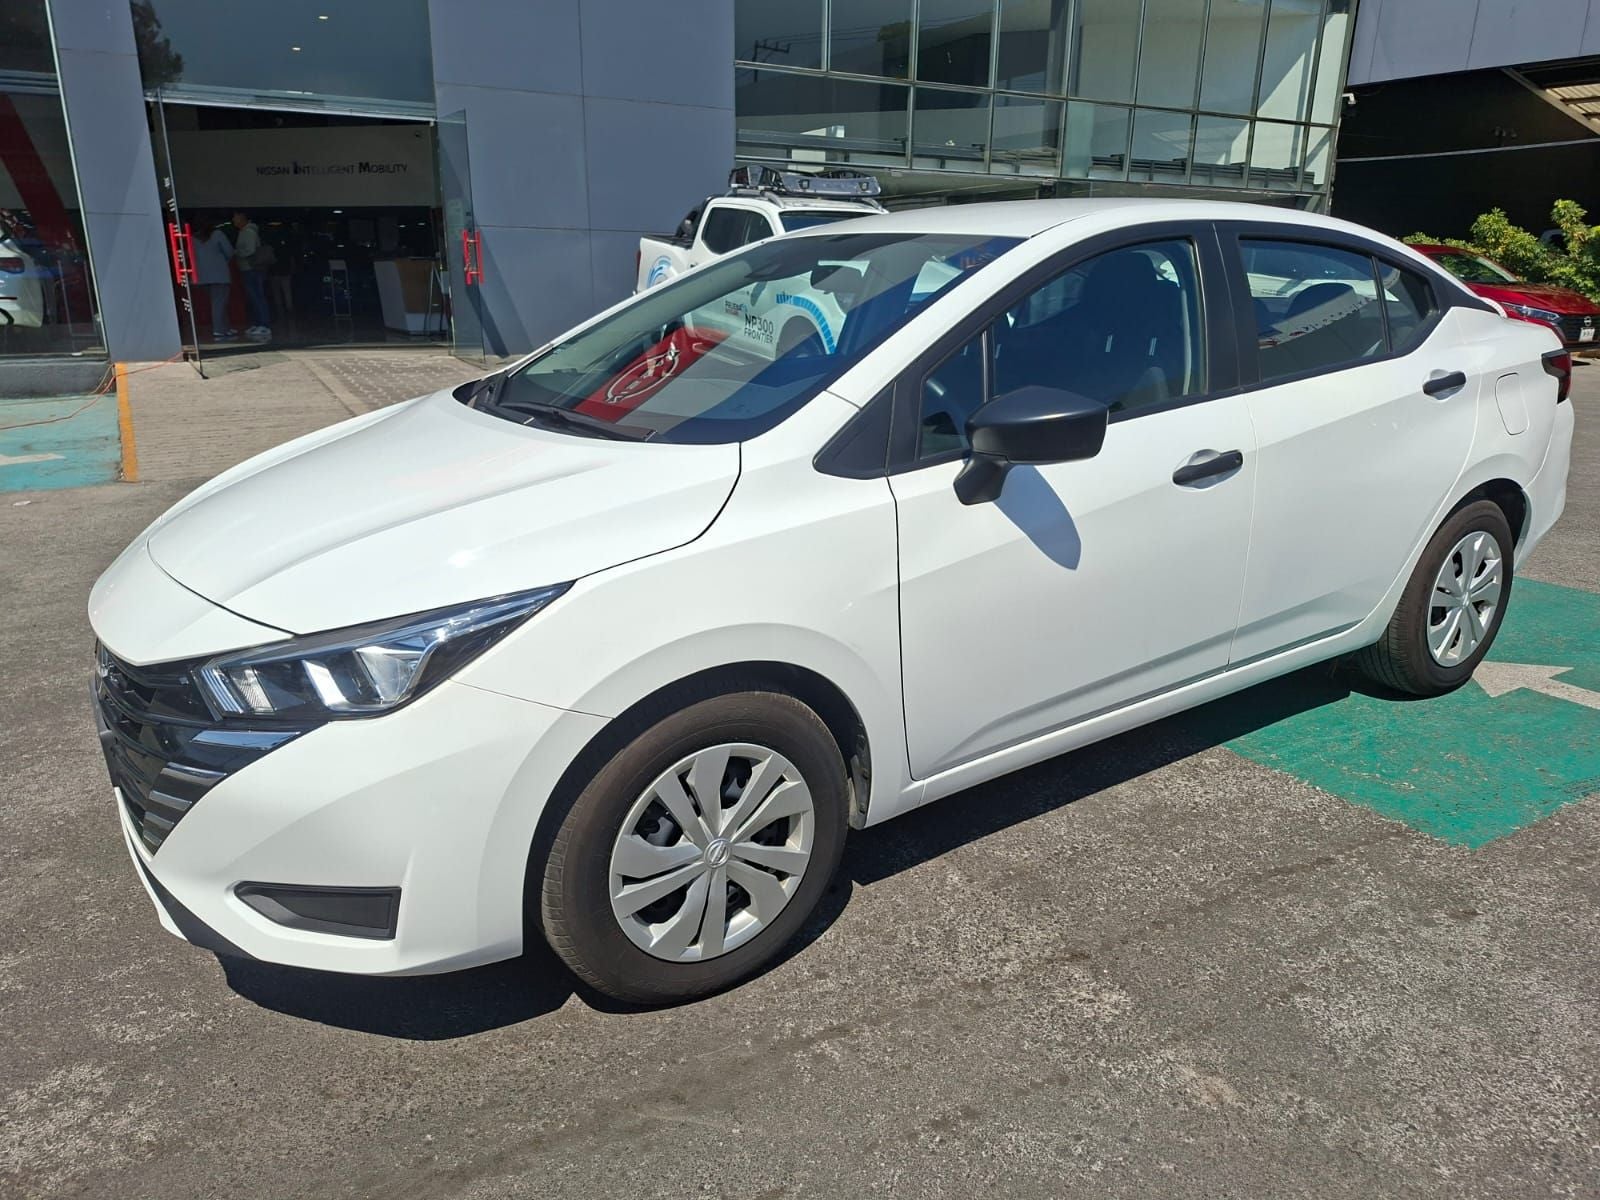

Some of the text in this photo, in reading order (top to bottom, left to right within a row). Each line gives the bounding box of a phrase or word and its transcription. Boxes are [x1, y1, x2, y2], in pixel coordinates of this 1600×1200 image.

[256, 161, 408, 176] NISSAN INTELLIGENT MOBILITY
[744, 313, 774, 335] NP300
[744, 327, 774, 344] FRONTIER
